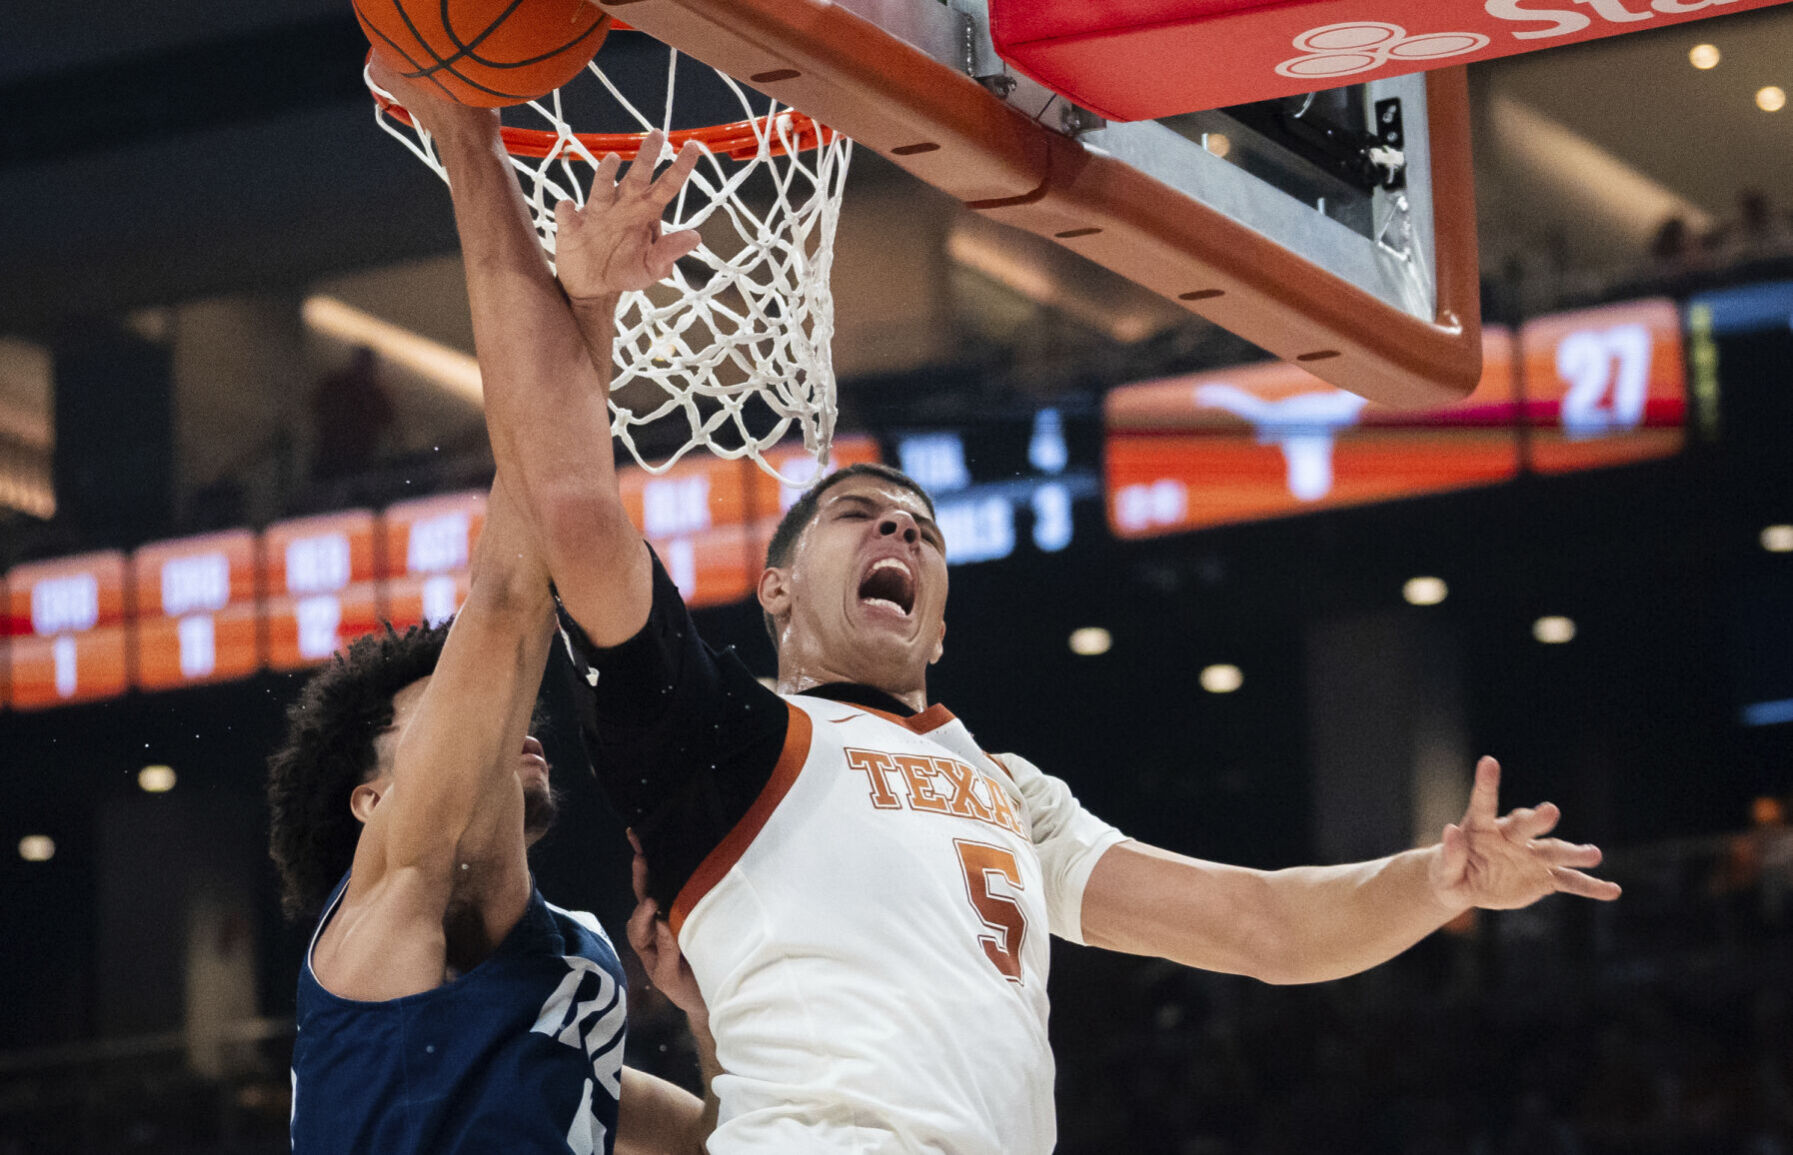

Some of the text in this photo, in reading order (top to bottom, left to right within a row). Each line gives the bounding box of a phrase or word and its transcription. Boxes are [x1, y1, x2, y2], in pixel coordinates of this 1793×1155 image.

[1556, 324, 1652, 440] 27
[844, 747, 1031, 842] TEXA
[952, 837, 1028, 987] 5
